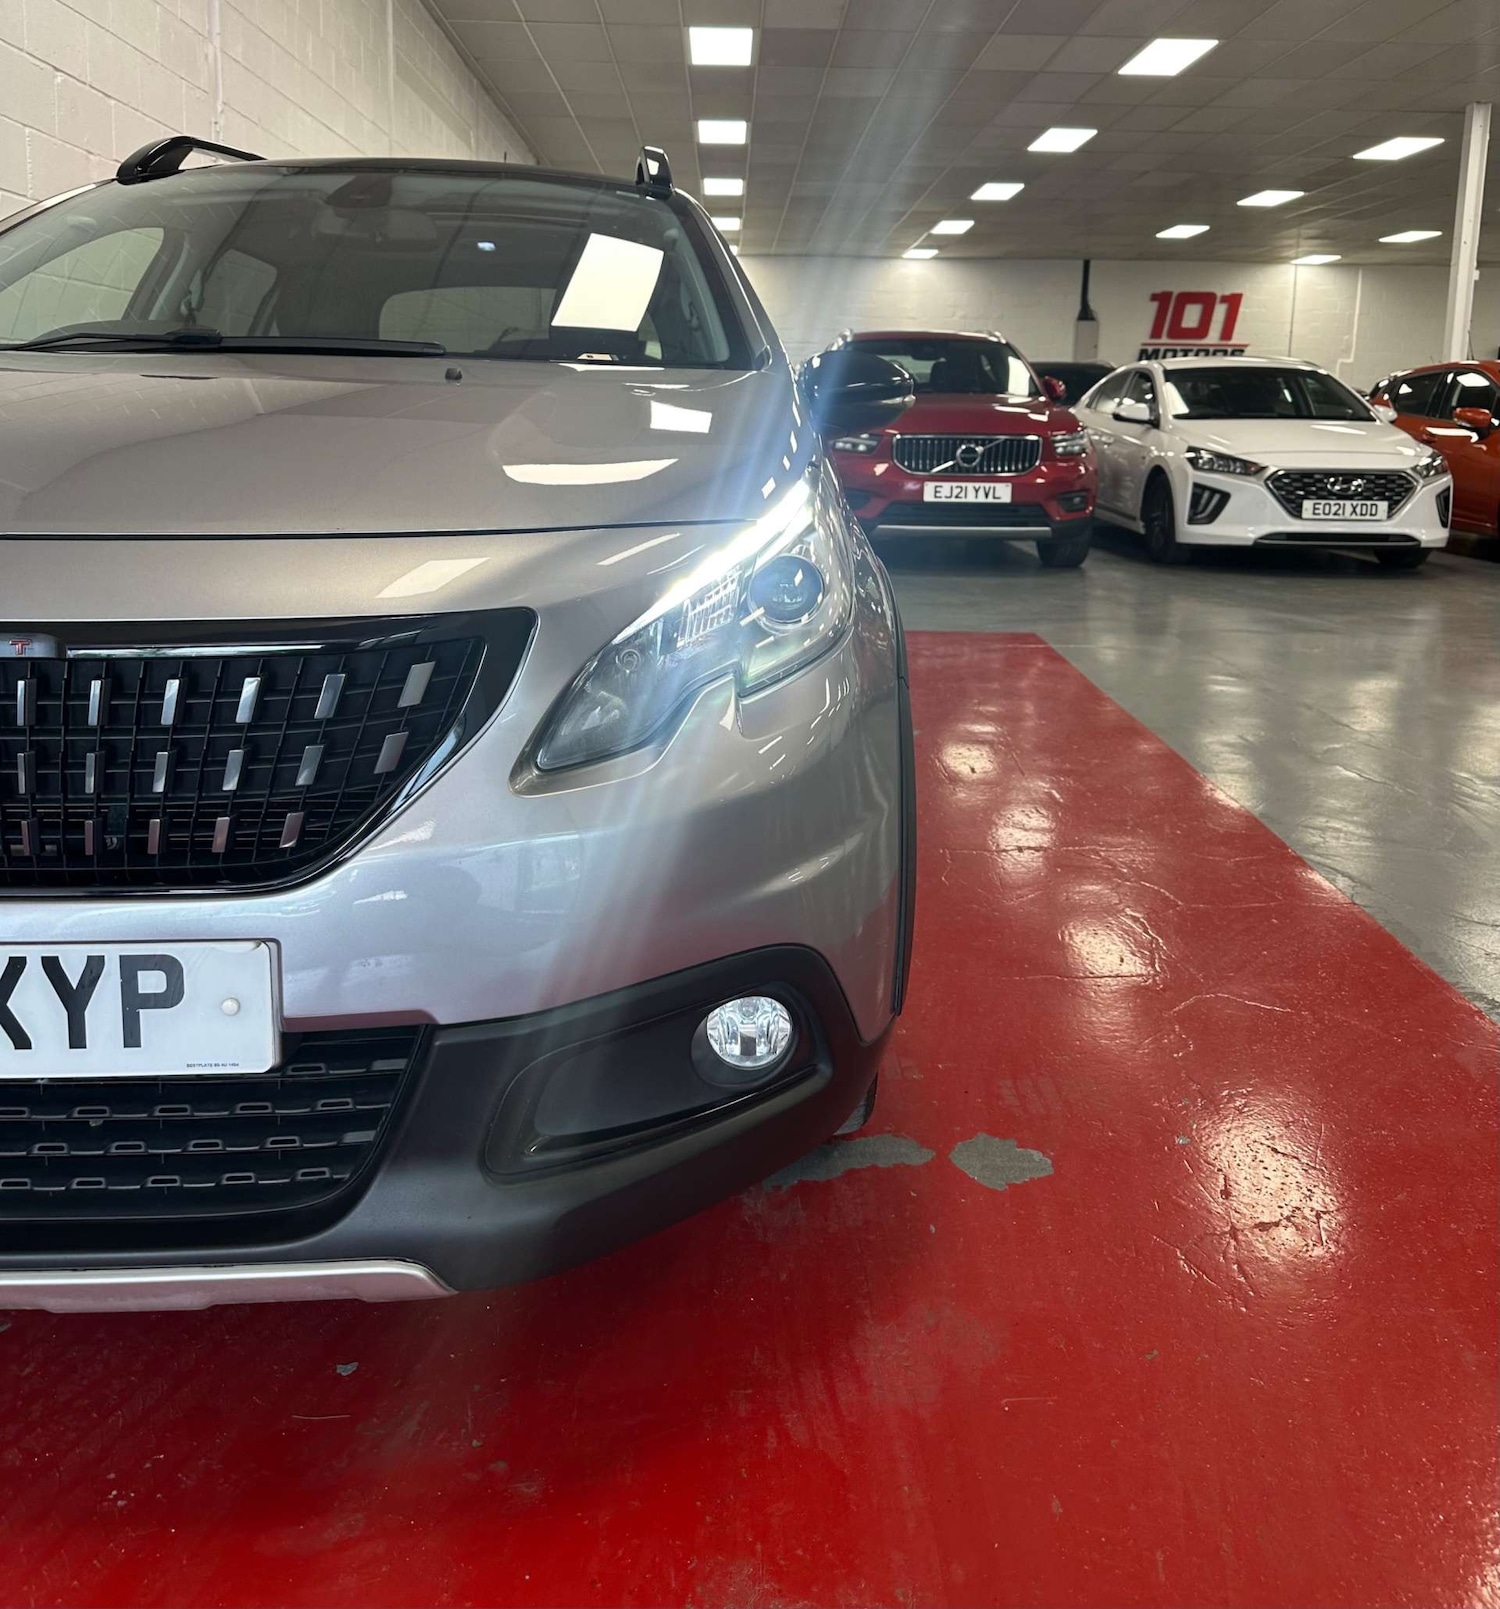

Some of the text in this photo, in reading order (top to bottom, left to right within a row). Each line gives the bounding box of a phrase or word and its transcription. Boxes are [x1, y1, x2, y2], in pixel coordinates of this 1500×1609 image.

[1149, 291, 1243, 341] 101
[934, 485, 1002, 500] EJ21 YVL
[1312, 502, 1378, 517] EO21 XDD
[9, 639, 31, 656] T
